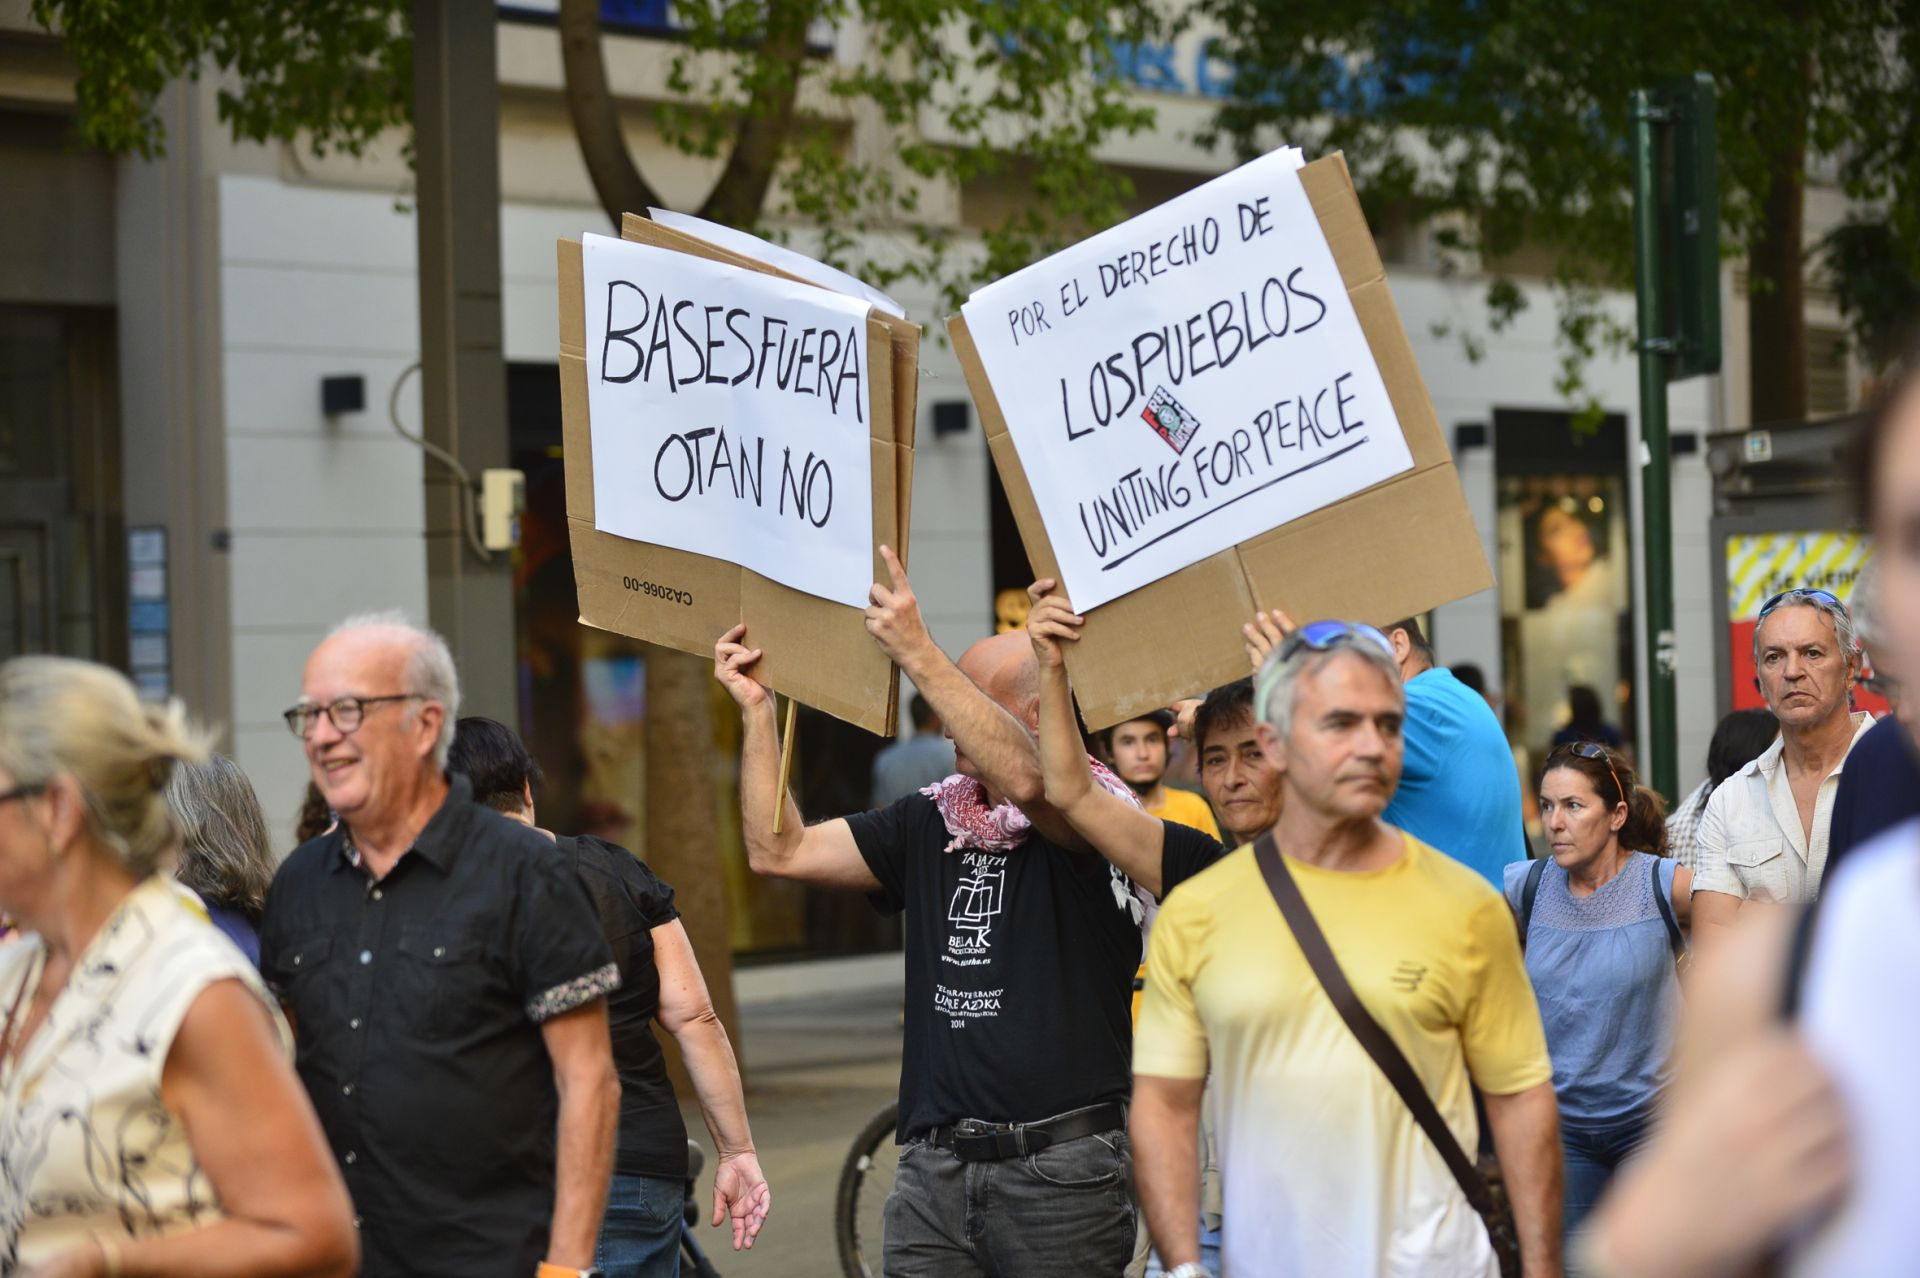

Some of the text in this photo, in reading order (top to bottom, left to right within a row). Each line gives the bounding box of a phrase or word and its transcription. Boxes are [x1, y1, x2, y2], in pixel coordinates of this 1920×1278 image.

[1008, 196, 1275, 346] POR EL DERECHO DE
[653, 425, 833, 529] OTAN NO
[1078, 460, 1192, 558] UNITING
[623, 576, 693, 606] CA2066-00
